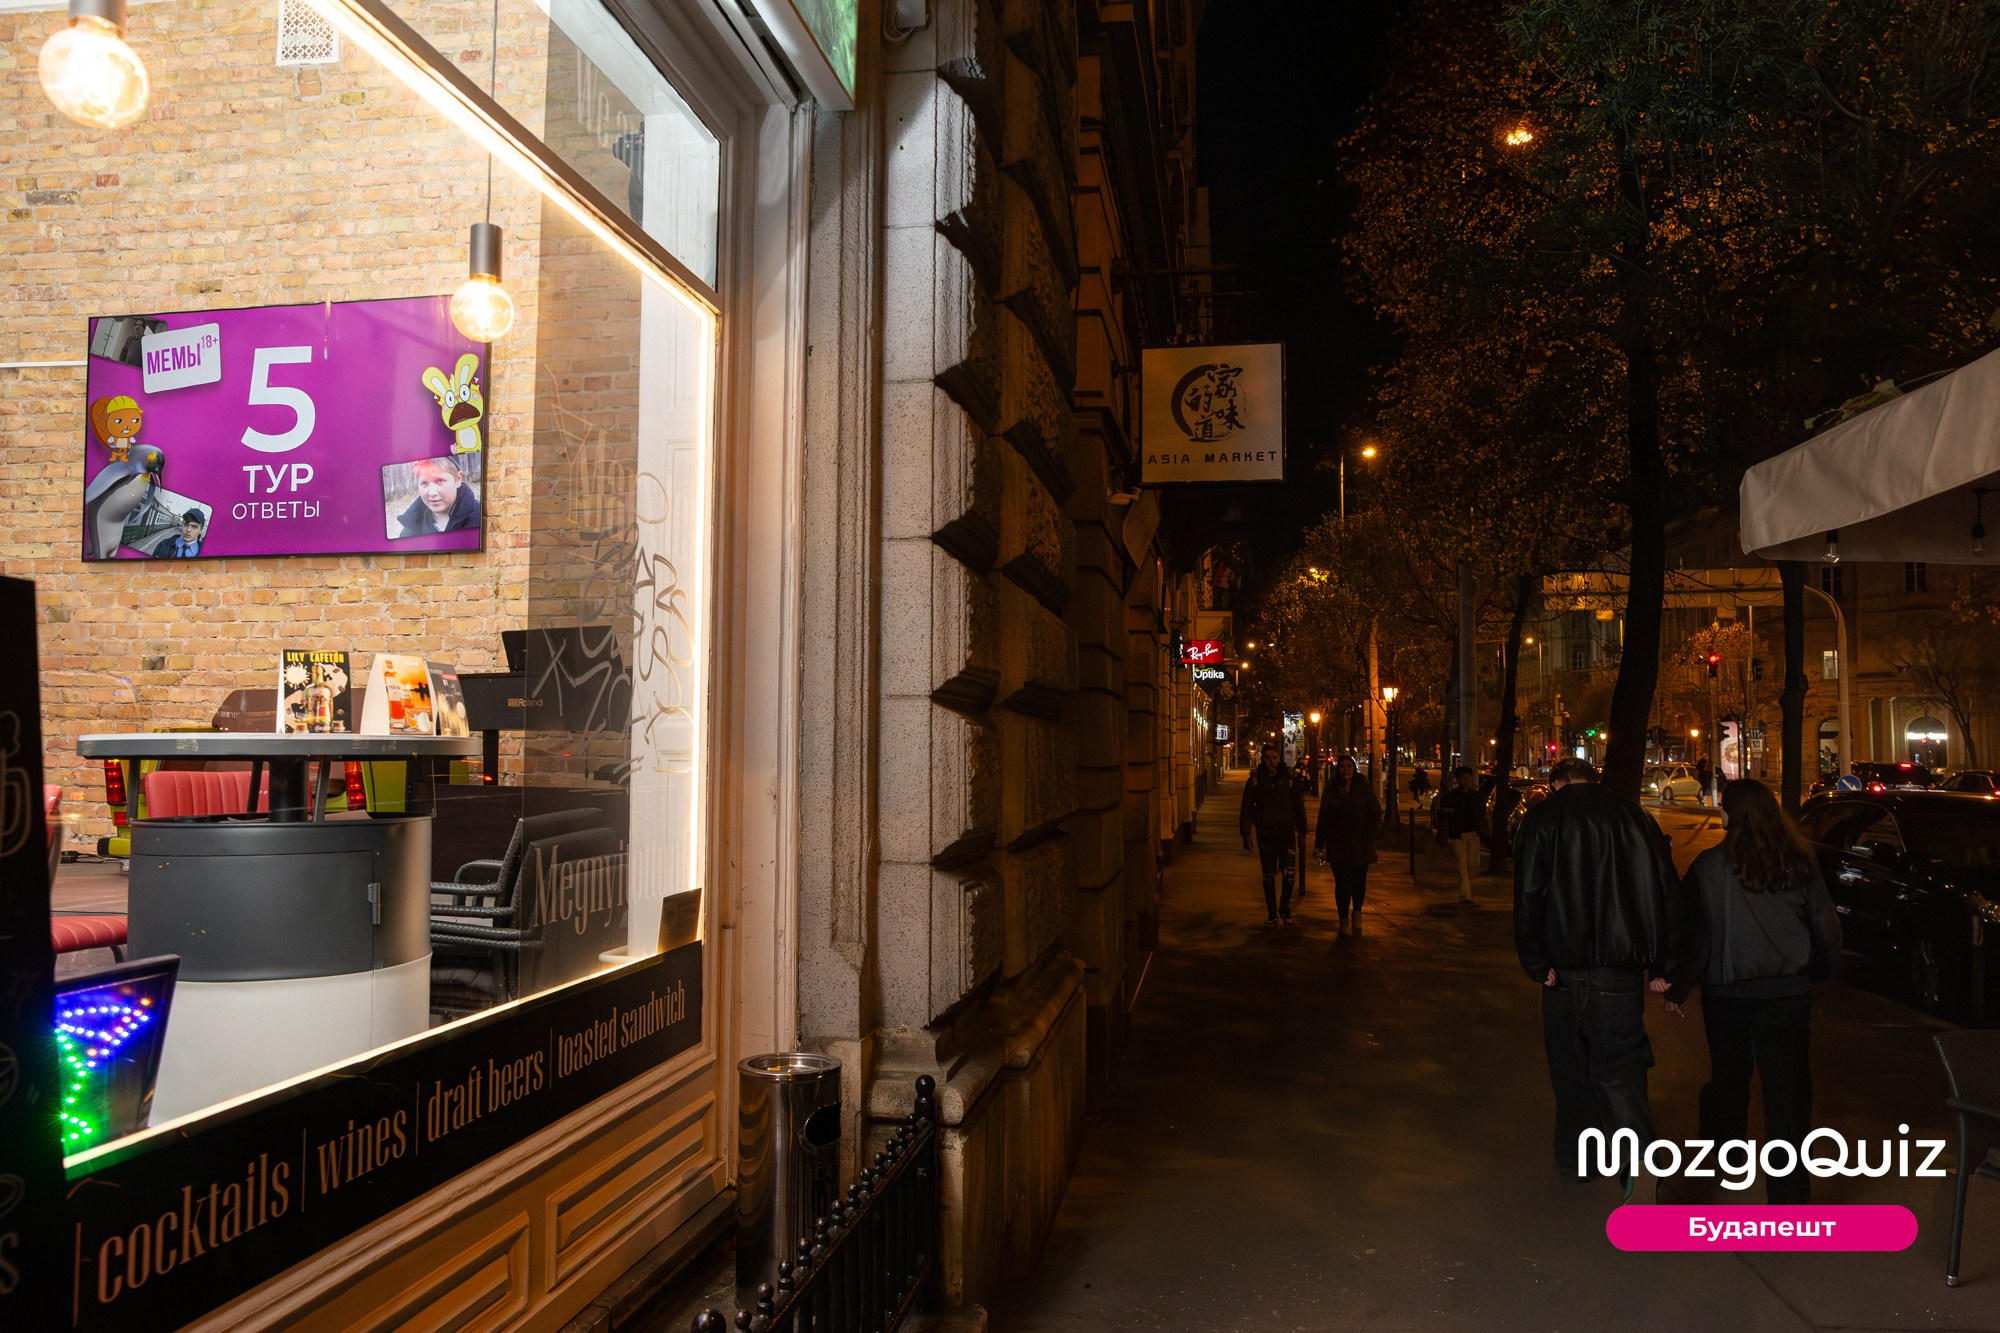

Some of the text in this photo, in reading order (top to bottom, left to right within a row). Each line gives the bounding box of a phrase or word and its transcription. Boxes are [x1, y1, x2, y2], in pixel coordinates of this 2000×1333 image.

[147, 335, 219, 375] МЕМЫ 18+
[241, 346, 316, 453] 5
[1148, 451, 1277, 464] ASIA MARKET
[243, 464, 314, 493] ТУР
[232, 501, 320, 520] ОТВЕТЫ
[1194, 669, 1224, 680] Optika
[100, 1153, 290, 1304] cocktails
[317, 1107, 407, 1195] wines
[427, 1065, 482, 1142] draft
[488, 1059, 544, 1114] beers
[558, 1007, 617, 1078] toasted
[621, 980, 685, 1049] sandwich
